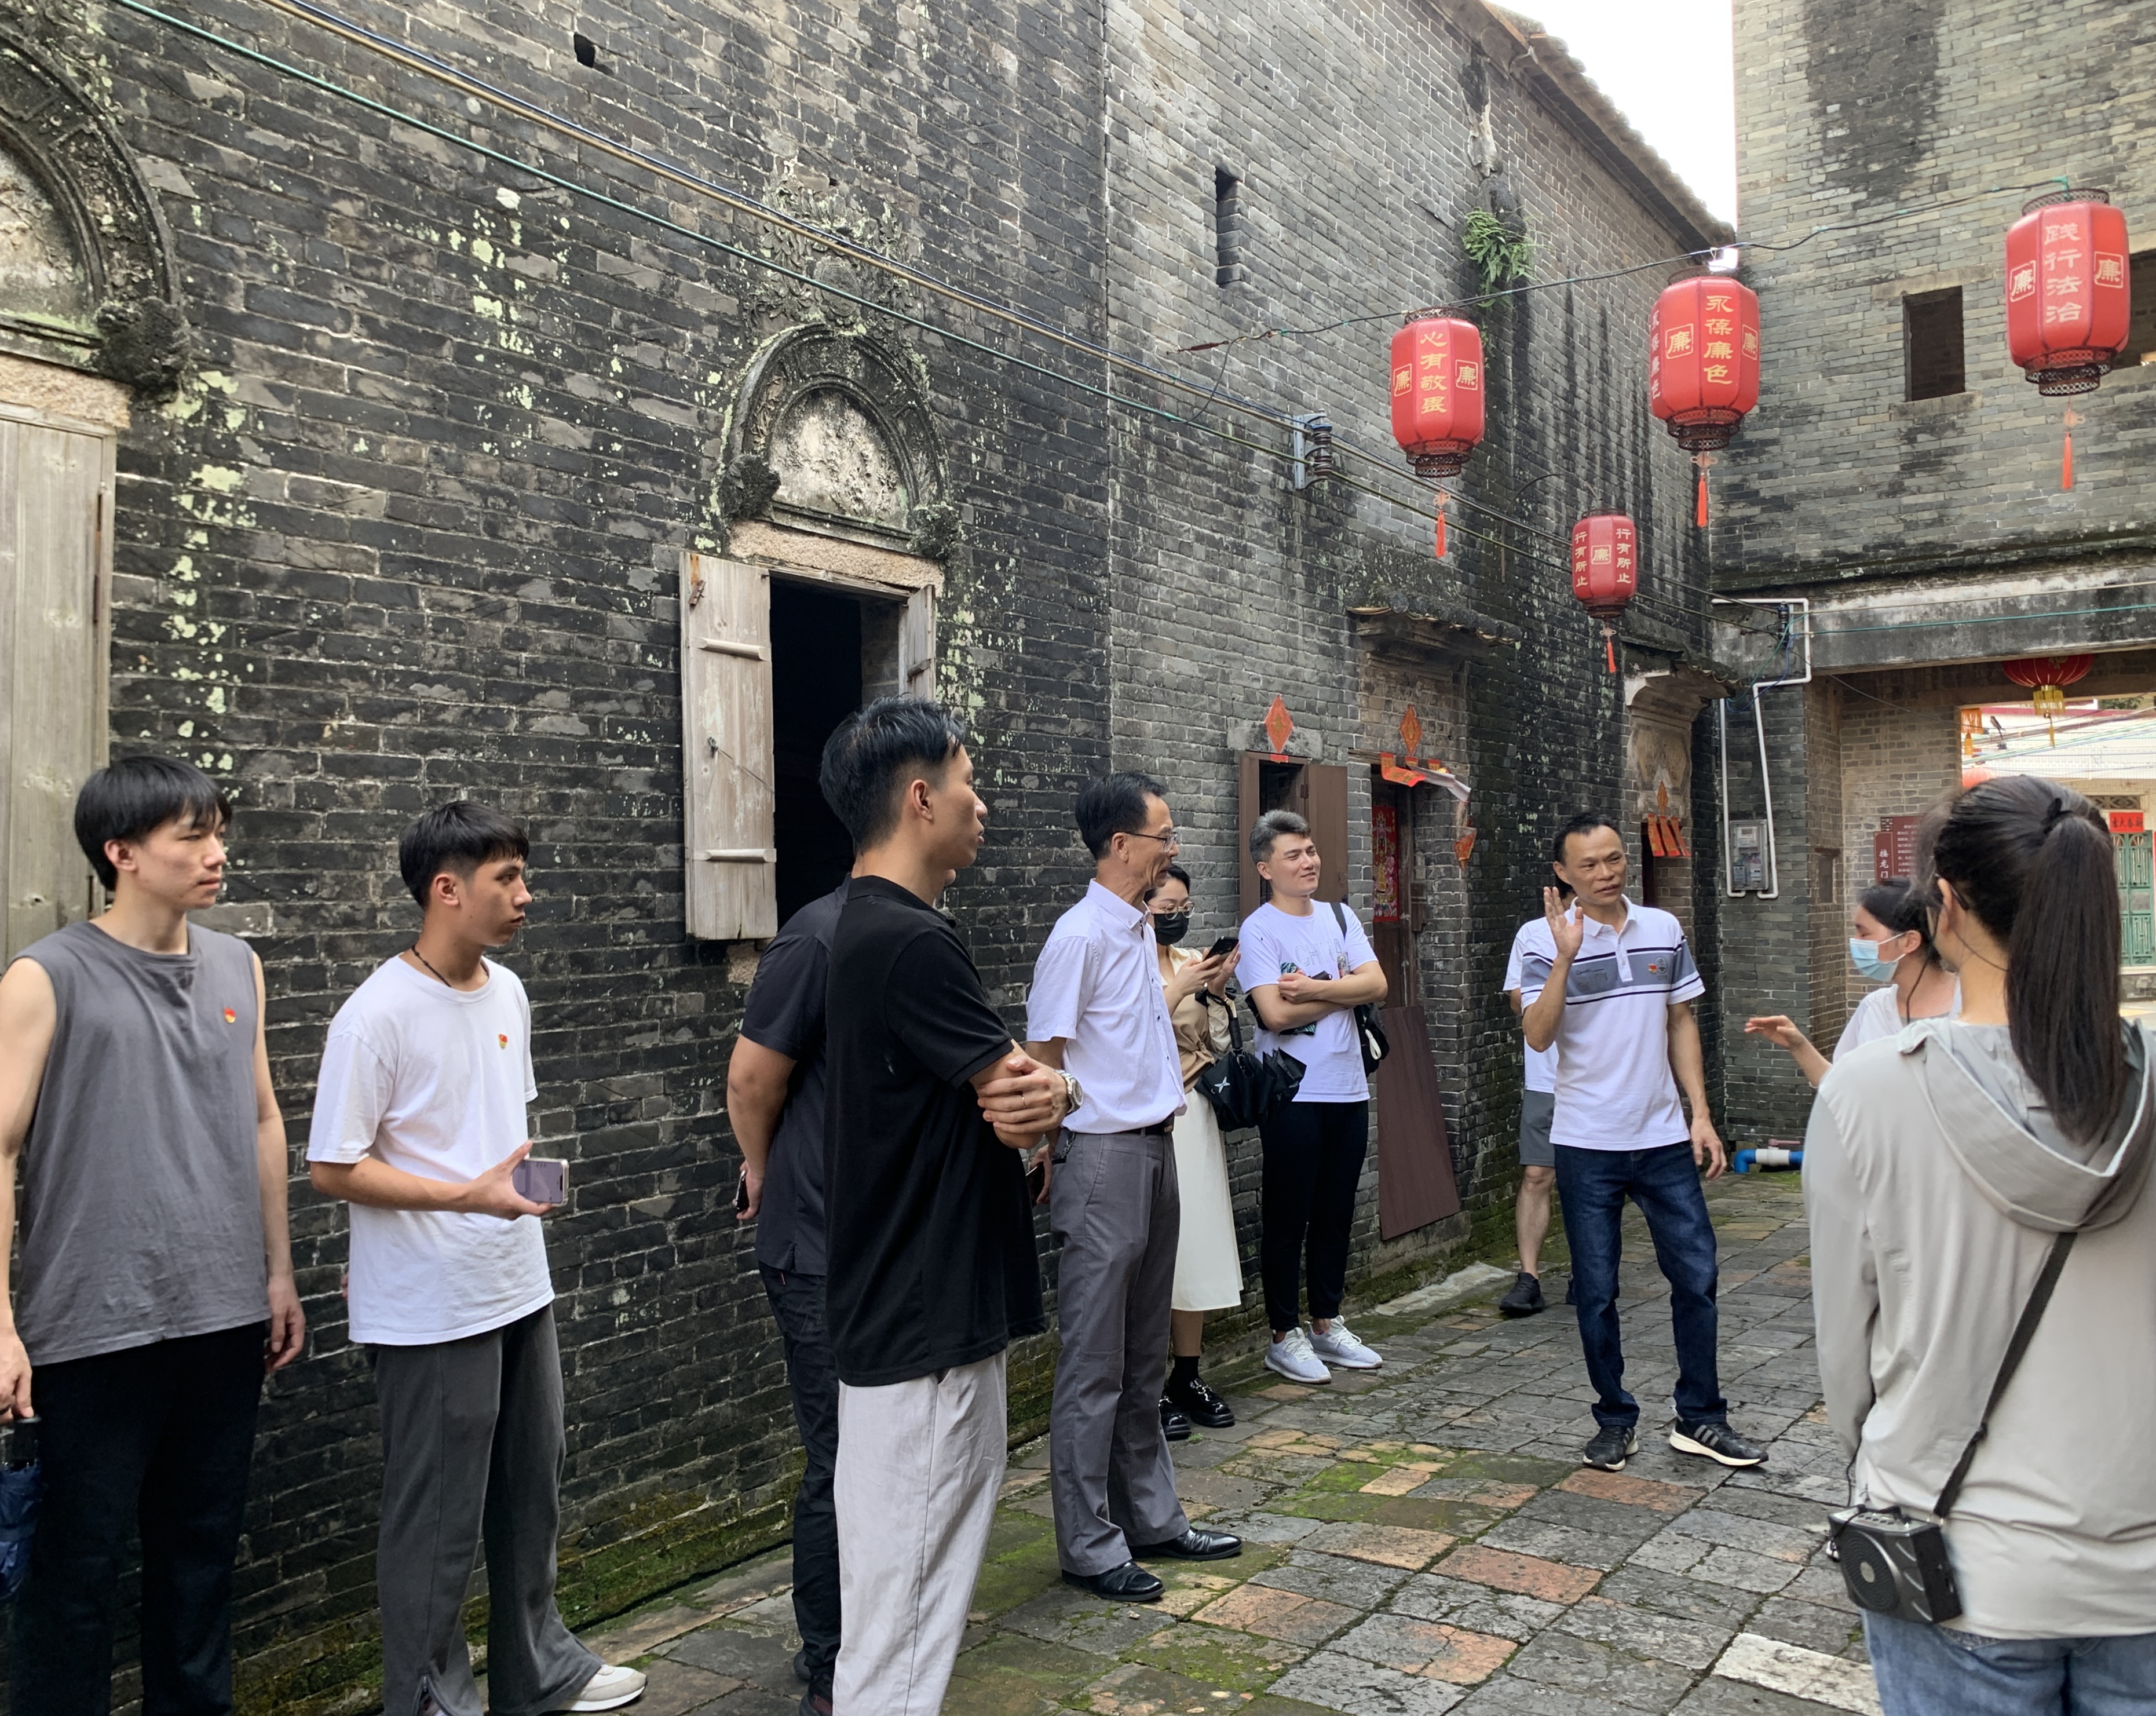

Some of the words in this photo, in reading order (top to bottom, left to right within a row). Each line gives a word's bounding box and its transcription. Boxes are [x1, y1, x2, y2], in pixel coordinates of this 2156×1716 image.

[2011, 268, 2034, 297] 廉
[2044, 221, 2082, 324] 践行法治
[2094, 258, 2122, 283] 廉
[1667, 330, 1693, 355] 廉
[1702, 295, 1735, 385] 永葆廉色
[1742, 332, 1756, 355] 廉
[1394, 369, 1410, 392] 廉
[1420, 330, 1448, 415] 心有敬畏
[1456, 364, 1475, 386] 廉
[1574, 531, 1588, 588] 行有所止
[1592, 547, 1610, 561] 廉
[1616, 527, 1632, 585] 行有所止
